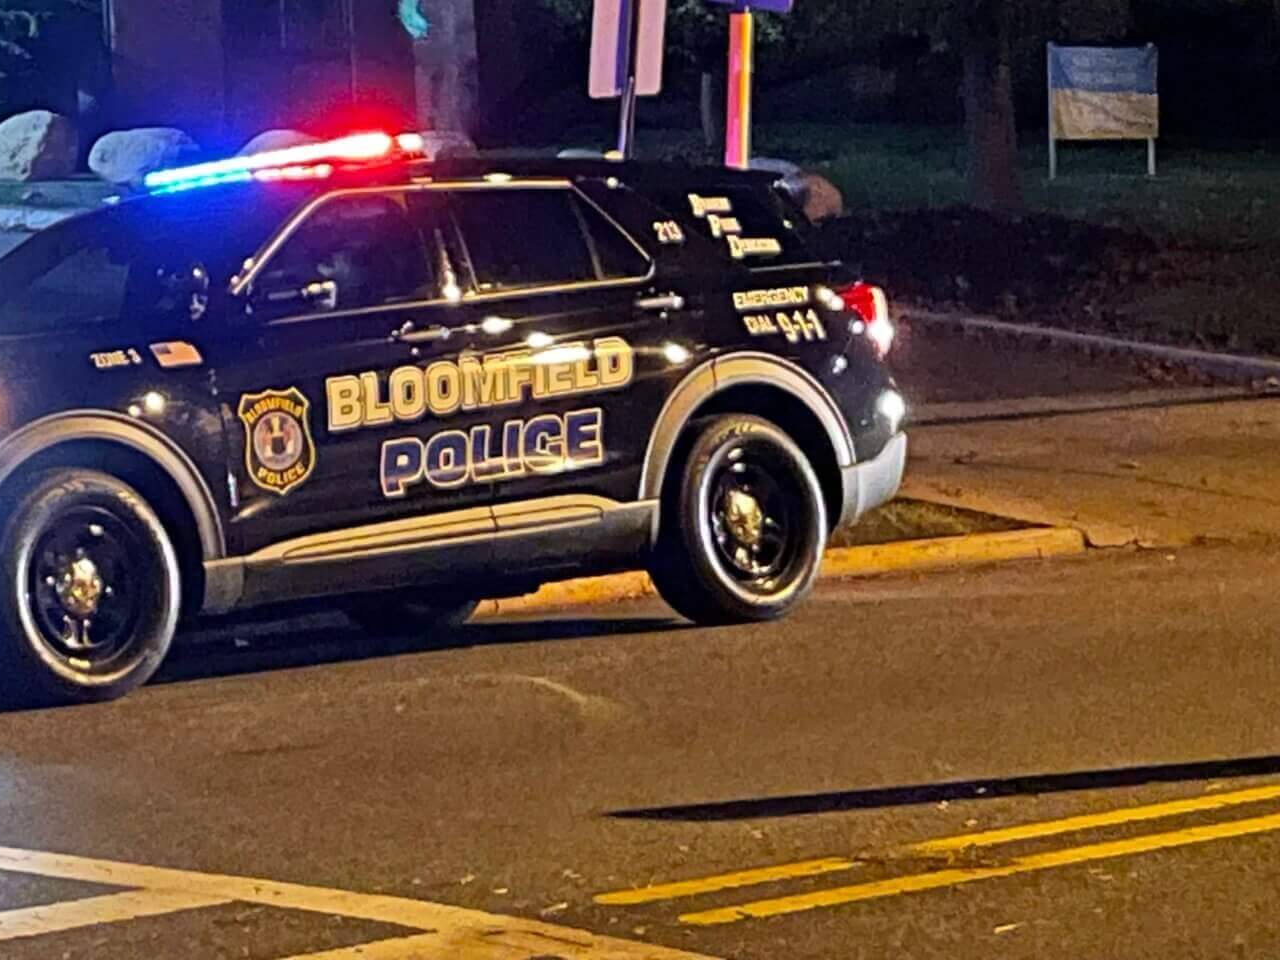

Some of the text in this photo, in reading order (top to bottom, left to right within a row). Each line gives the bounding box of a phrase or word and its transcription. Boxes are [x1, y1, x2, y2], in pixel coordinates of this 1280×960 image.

[653, 220, 684, 243] 213
[732, 286, 810, 310] EMERGENCY
[743, 316, 777, 336] DIAL
[325, 336, 635, 432] BLOOMFIELD
[243, 396, 304, 425] BLOOMFIELD
[380, 407, 604, 497] POLICE
[256, 462, 306, 486] POLICE
